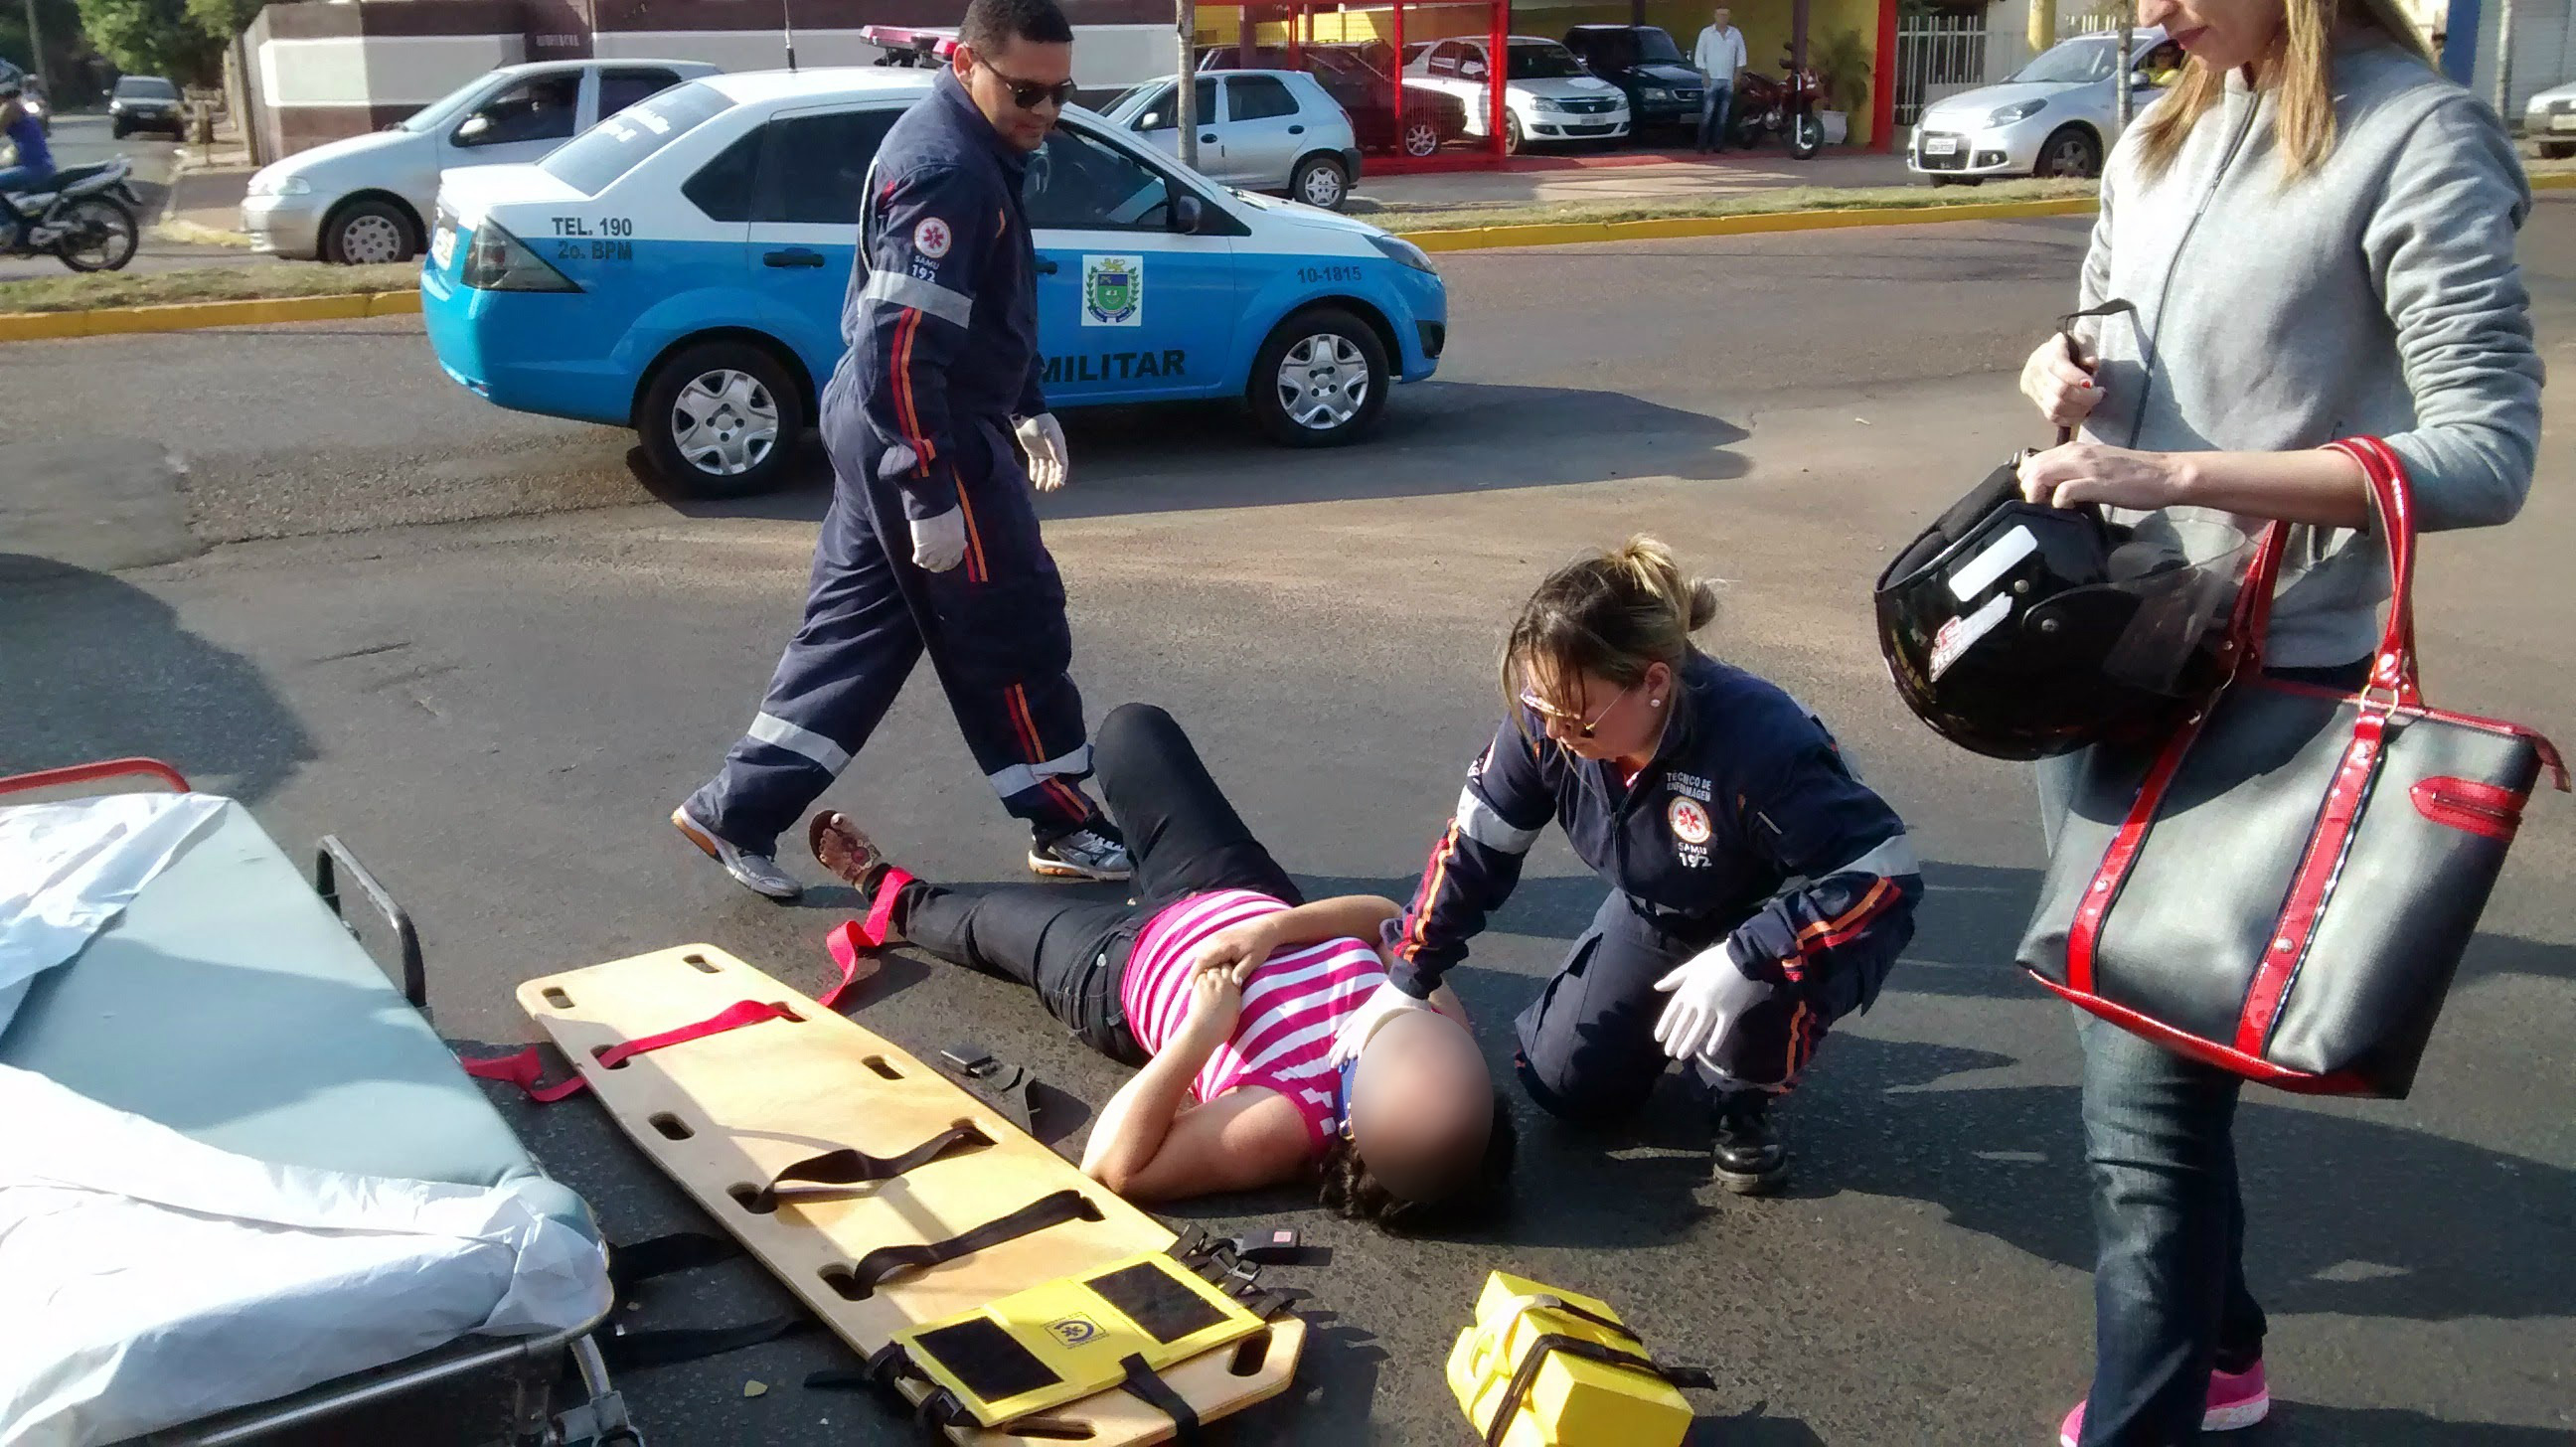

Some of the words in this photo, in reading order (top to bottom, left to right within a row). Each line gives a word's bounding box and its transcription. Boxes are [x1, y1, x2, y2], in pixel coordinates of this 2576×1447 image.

[552, 217, 593, 236] TEL.
[599, 217, 633, 237] 190
[558, 241, 586, 259] 2o.
[591, 241, 633, 260] BPM
[914, 254, 940, 270] SAMU
[911, 263, 936, 283] 192
[1297, 265, 1363, 284] 10-1815
[1042, 349, 1186, 384] MILITAR
[1701, 778, 1711, 791] DE
[1678, 842, 1707, 856] SAMU
[1679, 852, 1712, 868] 192
